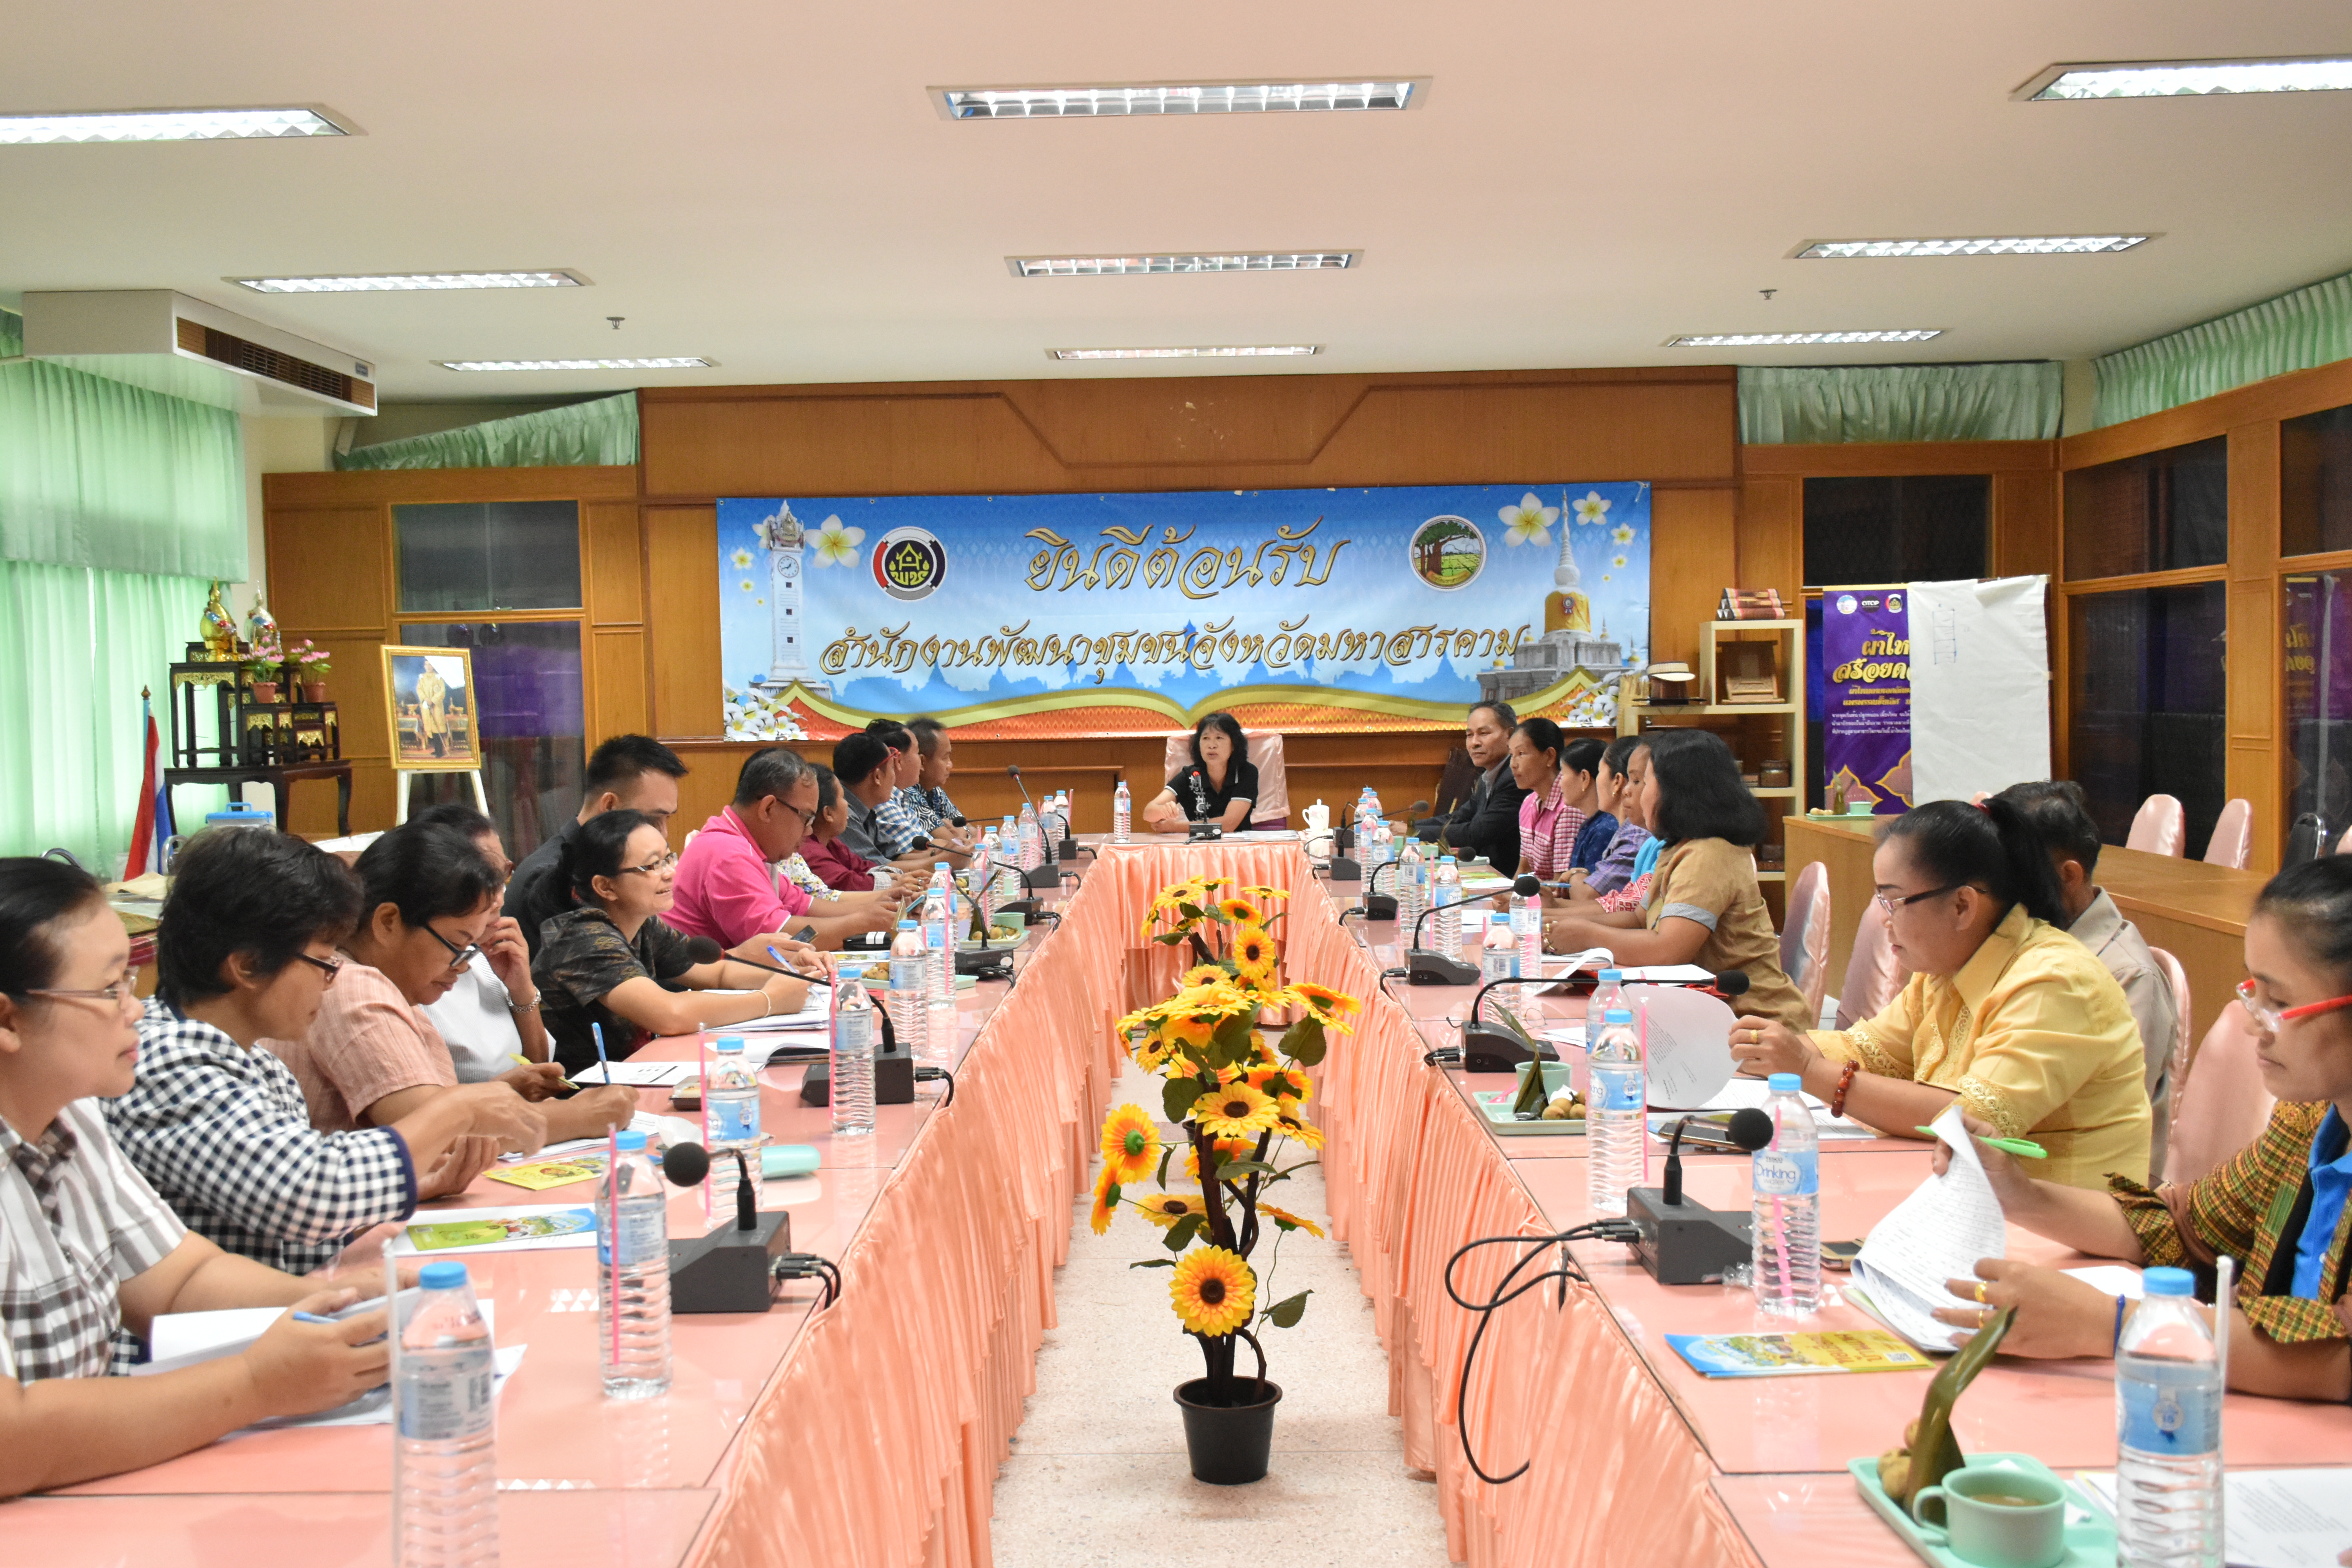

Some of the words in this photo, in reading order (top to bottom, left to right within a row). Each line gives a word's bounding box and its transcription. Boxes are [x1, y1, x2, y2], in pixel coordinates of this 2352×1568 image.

[1024, 515, 1351, 600] ยินดีต้อนรับ
[818, 615, 1530, 684] สำนักงานพัฒนาชุมชนจังหวัดมหาสารคาม
[1756, 1162, 1796, 1184] Drinking
